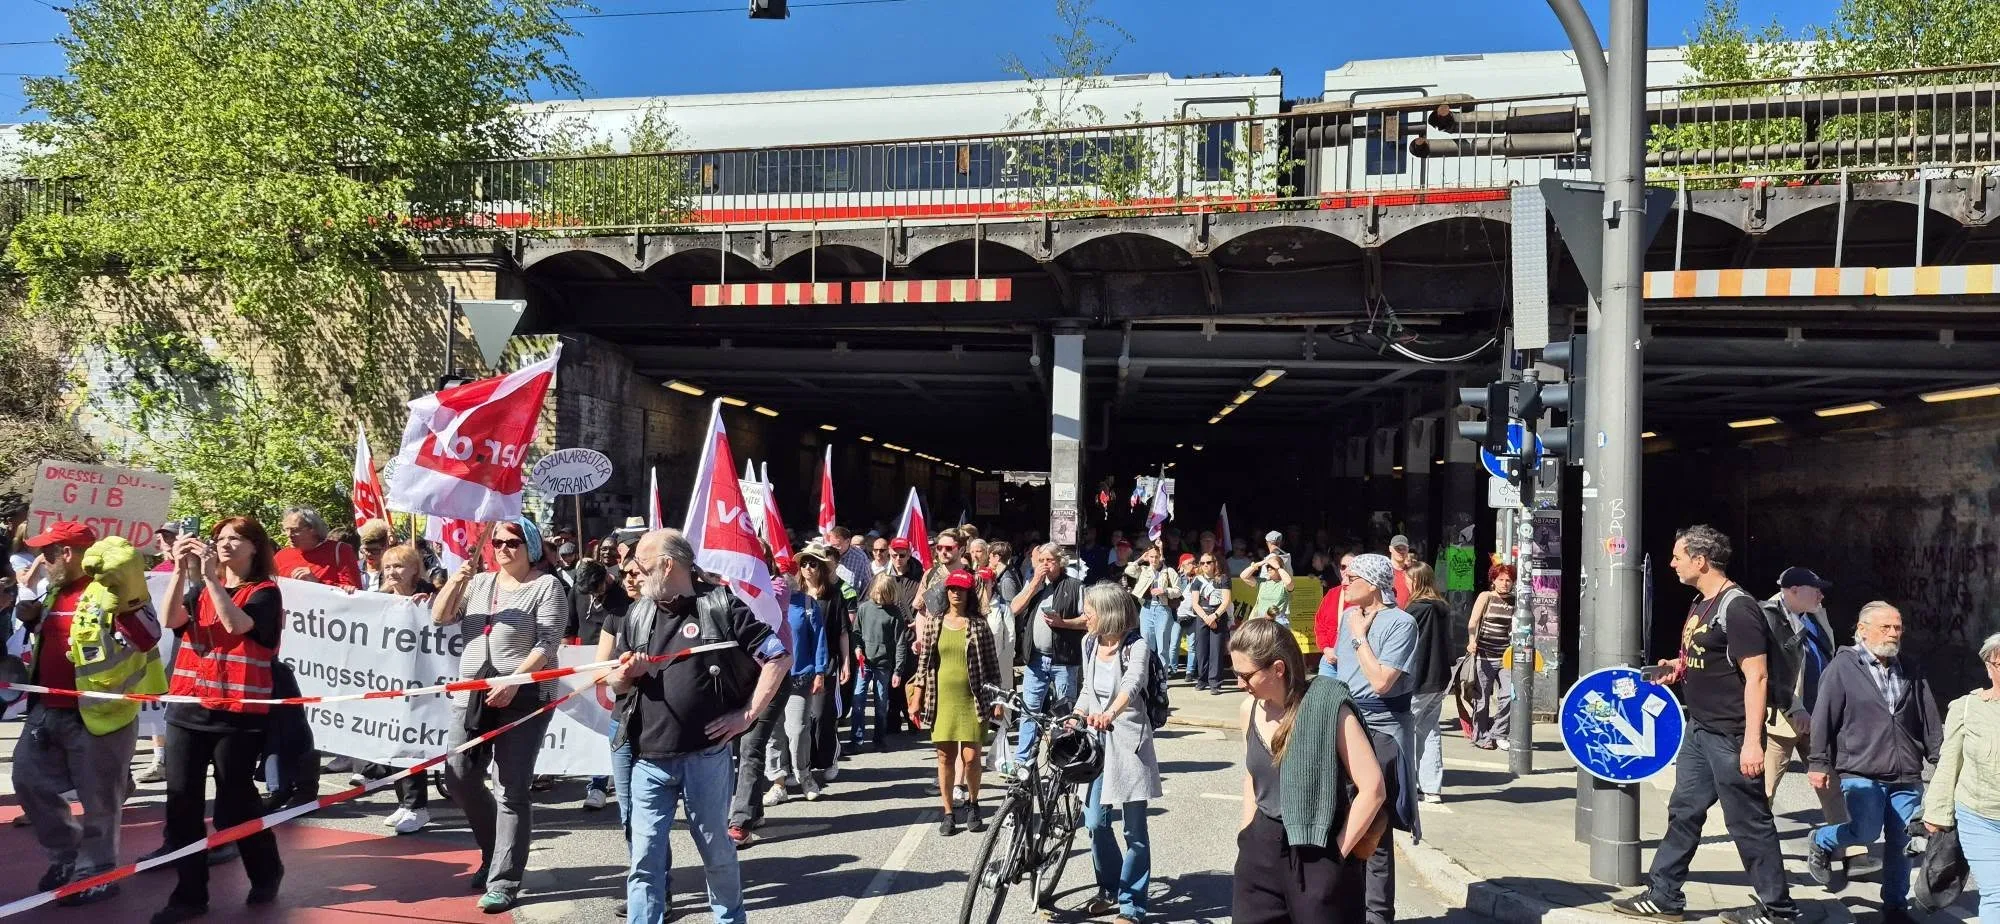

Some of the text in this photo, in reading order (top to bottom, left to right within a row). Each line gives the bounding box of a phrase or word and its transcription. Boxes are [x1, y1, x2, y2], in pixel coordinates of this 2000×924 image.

[533, 449, 611, 478] SOZIALARBEITER
[46, 466, 165, 491] DRESSEL DU...
[541, 474, 594, 493] MIGRANT
[63, 483, 123, 508] GIB
[1532, 597, 1557, 605] ABTANZ
